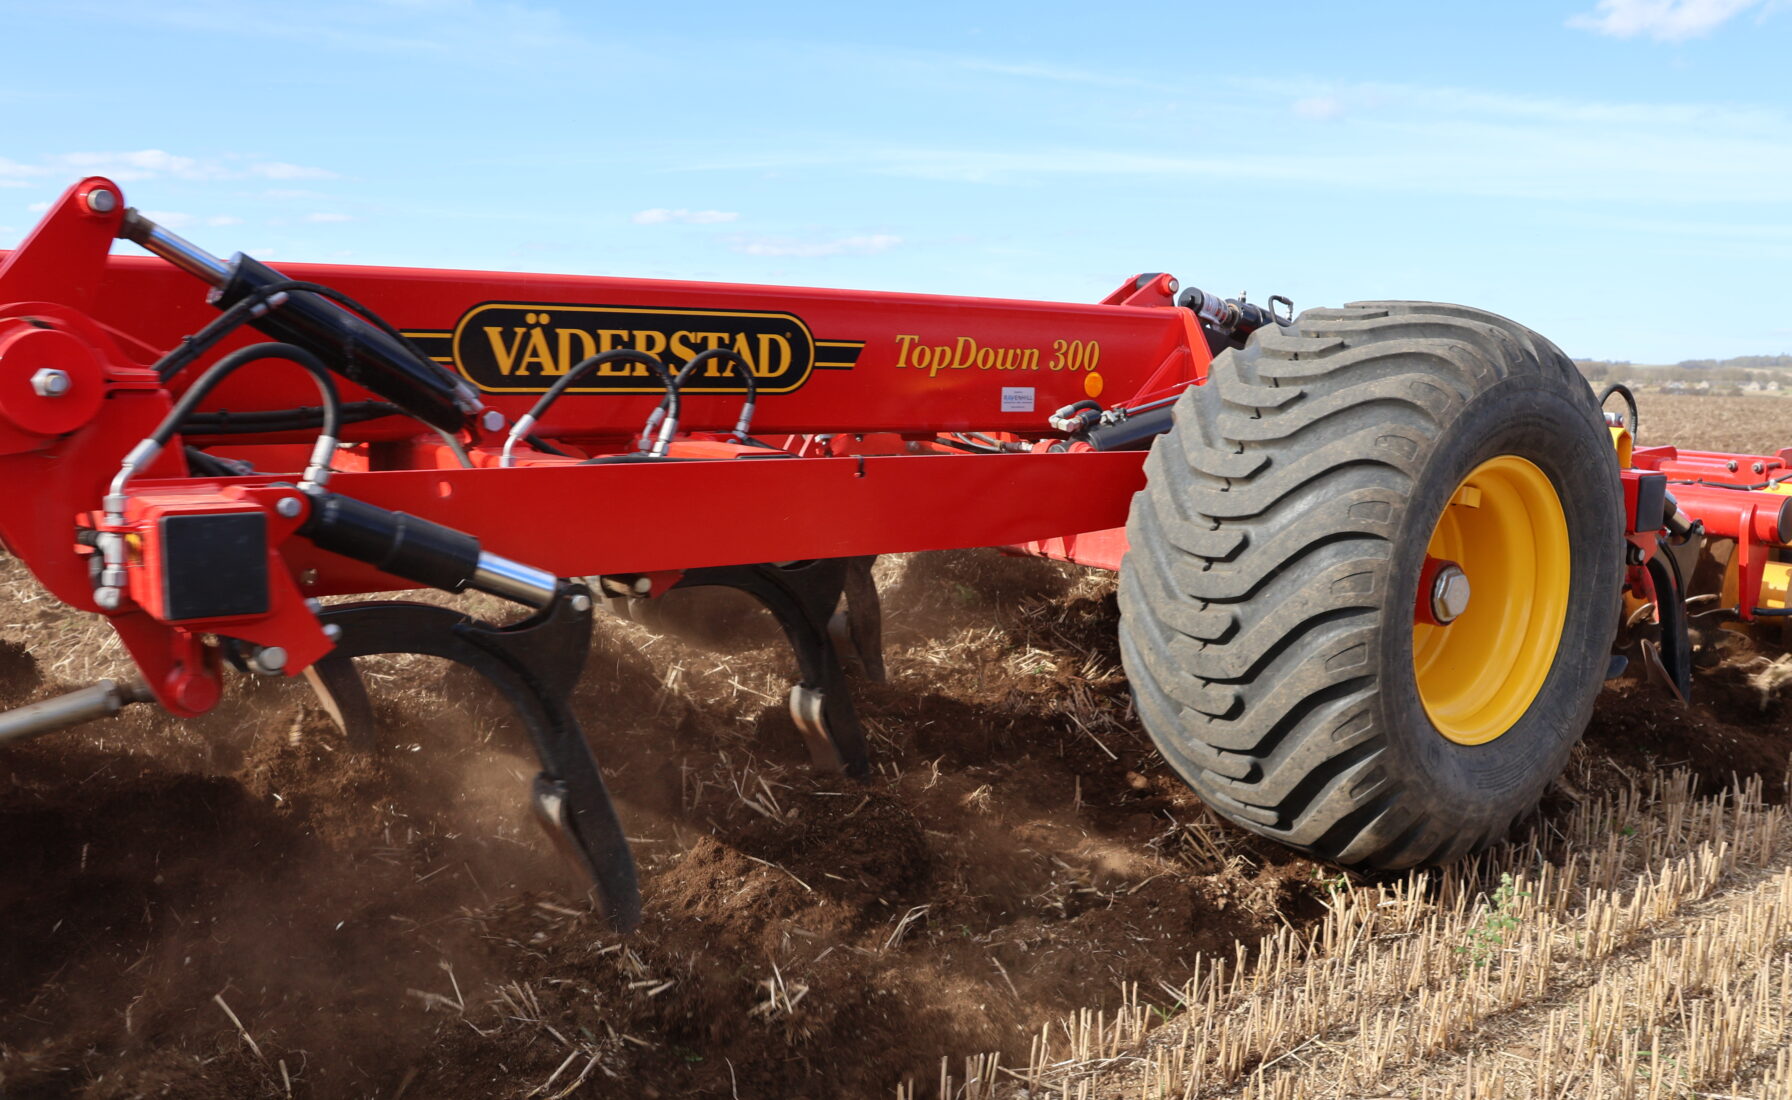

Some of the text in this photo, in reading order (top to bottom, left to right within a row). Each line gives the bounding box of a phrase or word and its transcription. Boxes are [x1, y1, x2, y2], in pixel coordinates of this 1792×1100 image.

[483, 312, 792, 378] VÄDERSTAD
[895, 334, 1100, 377] TopDown 300
